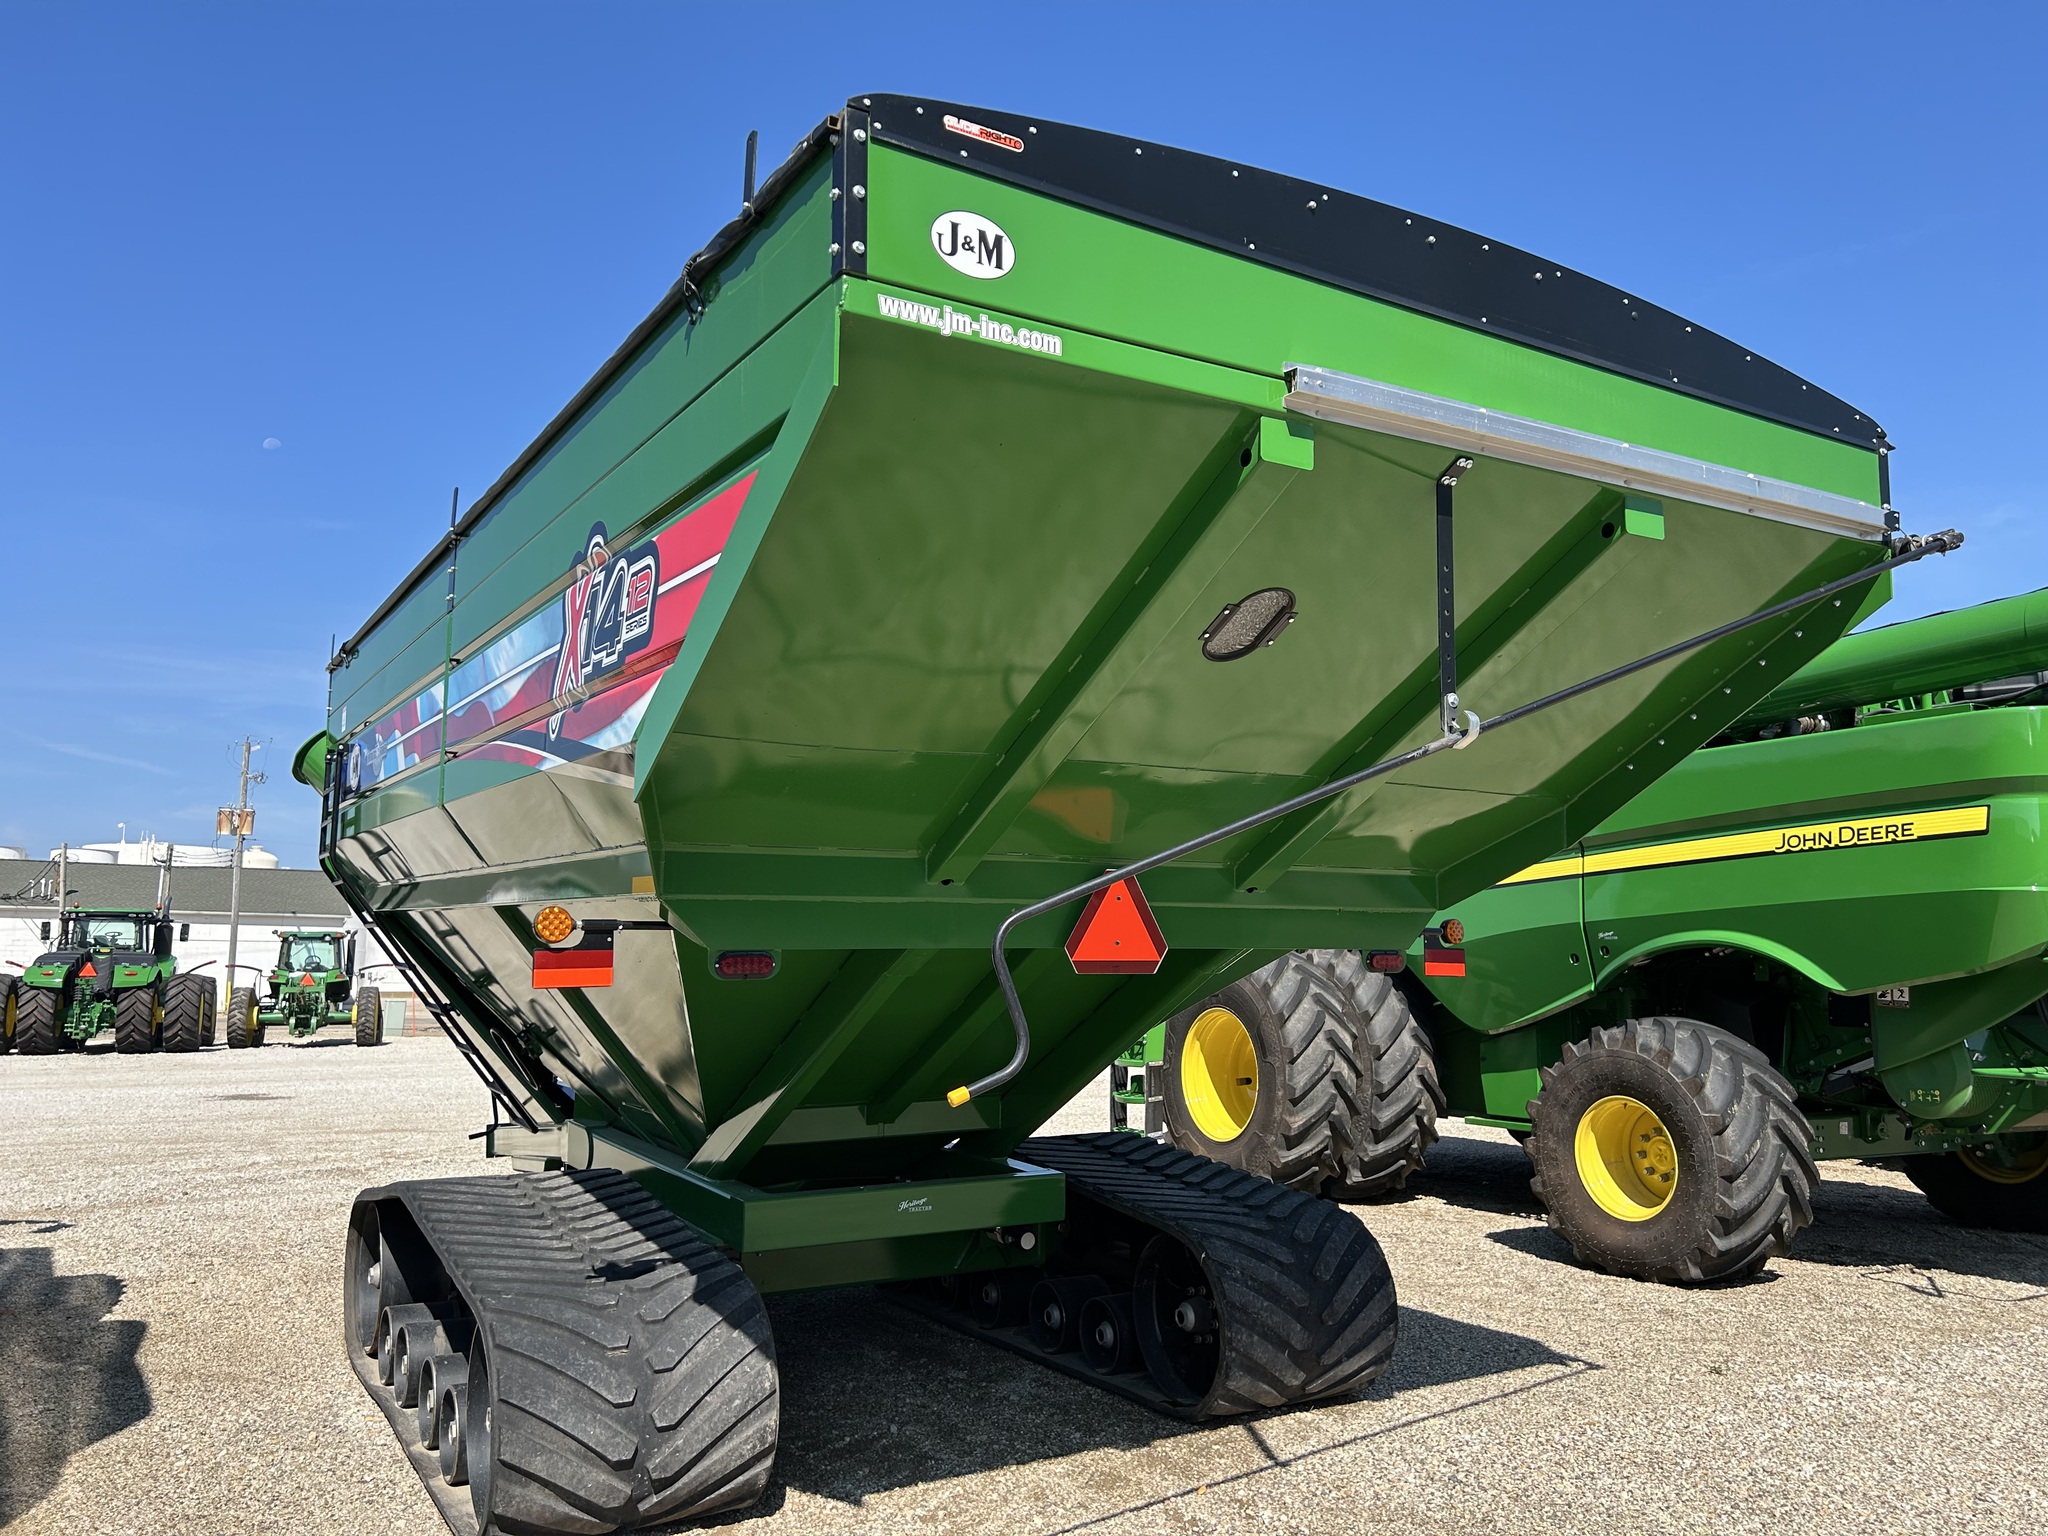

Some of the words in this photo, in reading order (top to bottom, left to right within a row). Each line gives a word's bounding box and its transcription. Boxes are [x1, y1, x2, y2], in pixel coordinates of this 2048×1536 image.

[936, 220, 1005, 271] J&M
[877, 293, 1062, 356] www.jm-inc.com
[625, 614, 648, 635] SERIES
[1775, 830, 1832, 850] JOHN
[1838, 822, 1915, 844] DEERE
[897, 1197, 928, 1212] Heritage
[908, 1205, 933, 1213] TRACTOR
